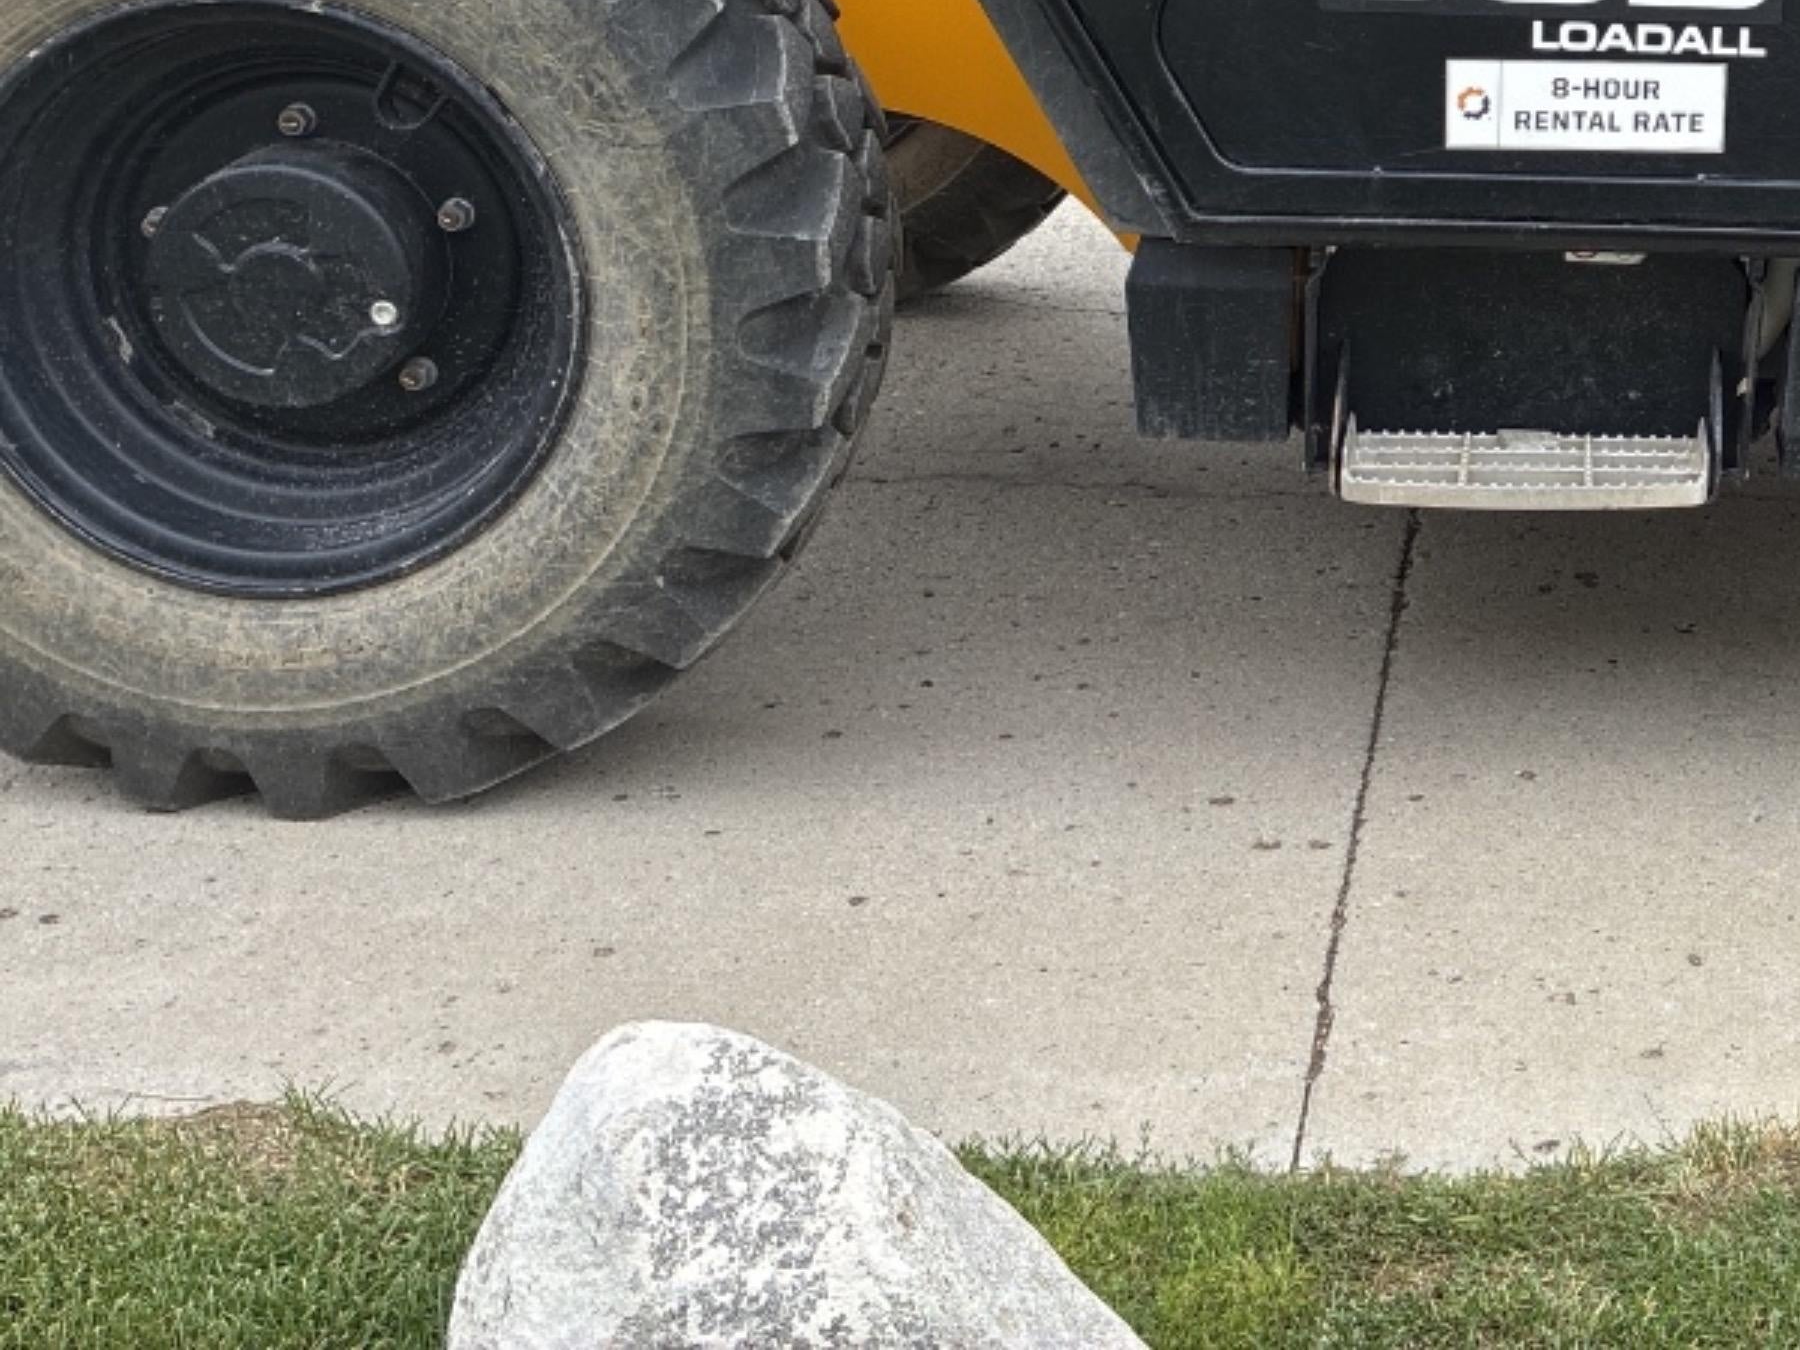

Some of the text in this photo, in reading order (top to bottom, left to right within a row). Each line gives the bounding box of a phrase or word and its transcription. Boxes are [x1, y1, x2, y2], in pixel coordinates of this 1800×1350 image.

[1531, 20, 1768, 58] LOADALL
[1550, 77, 1660, 101] 8-HOUR
[1514, 110, 1705, 134] RENTAL RATE
